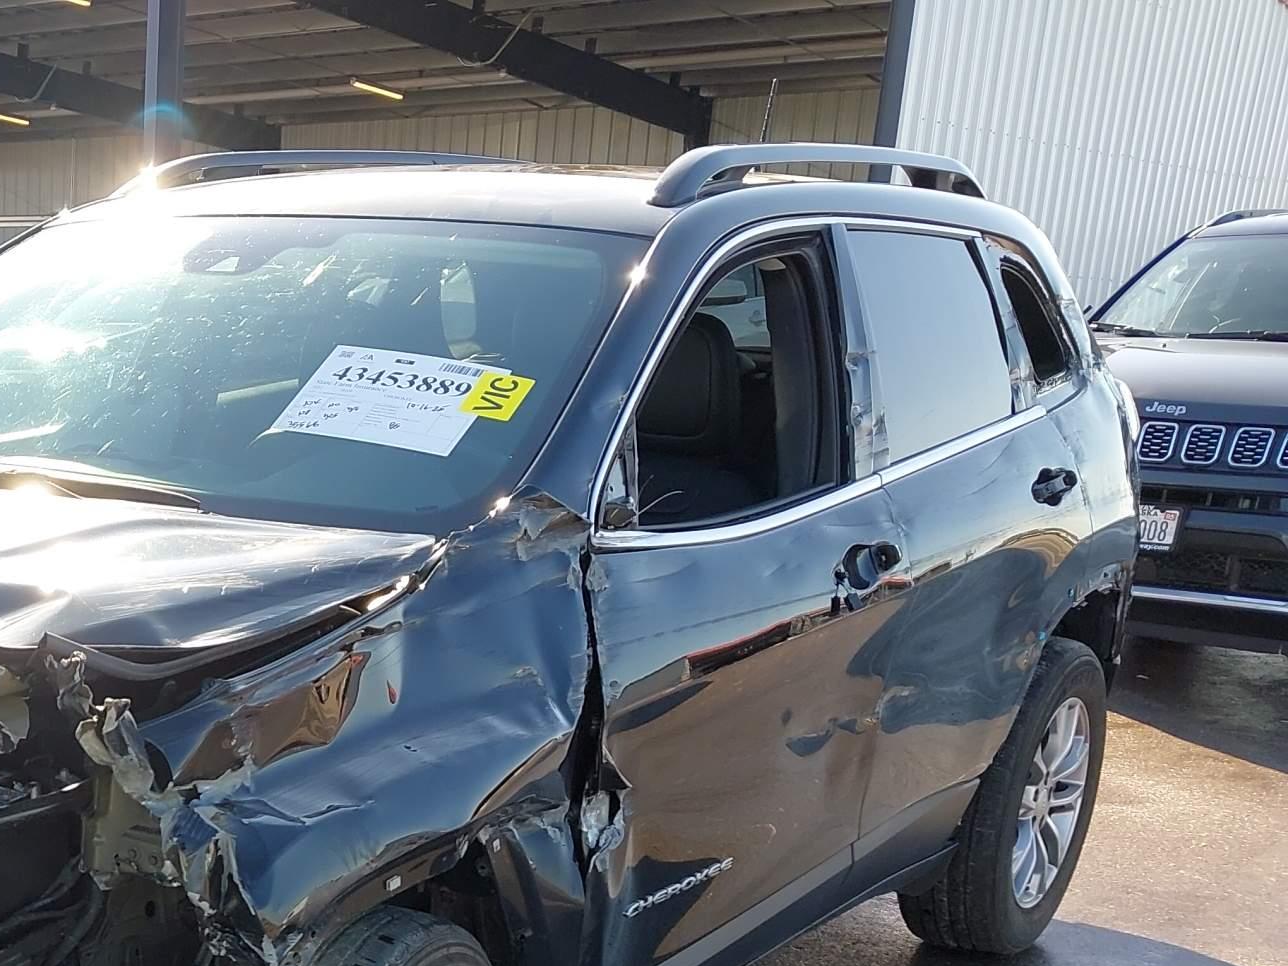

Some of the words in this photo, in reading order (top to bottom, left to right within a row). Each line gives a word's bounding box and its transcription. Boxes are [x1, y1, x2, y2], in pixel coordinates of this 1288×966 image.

[332, 366, 472, 397] 43453889
[472, 377, 520, 412] VIC
[1145, 401, 1187, 416] Jeep
[622, 856, 735, 918] CHEROKEE
